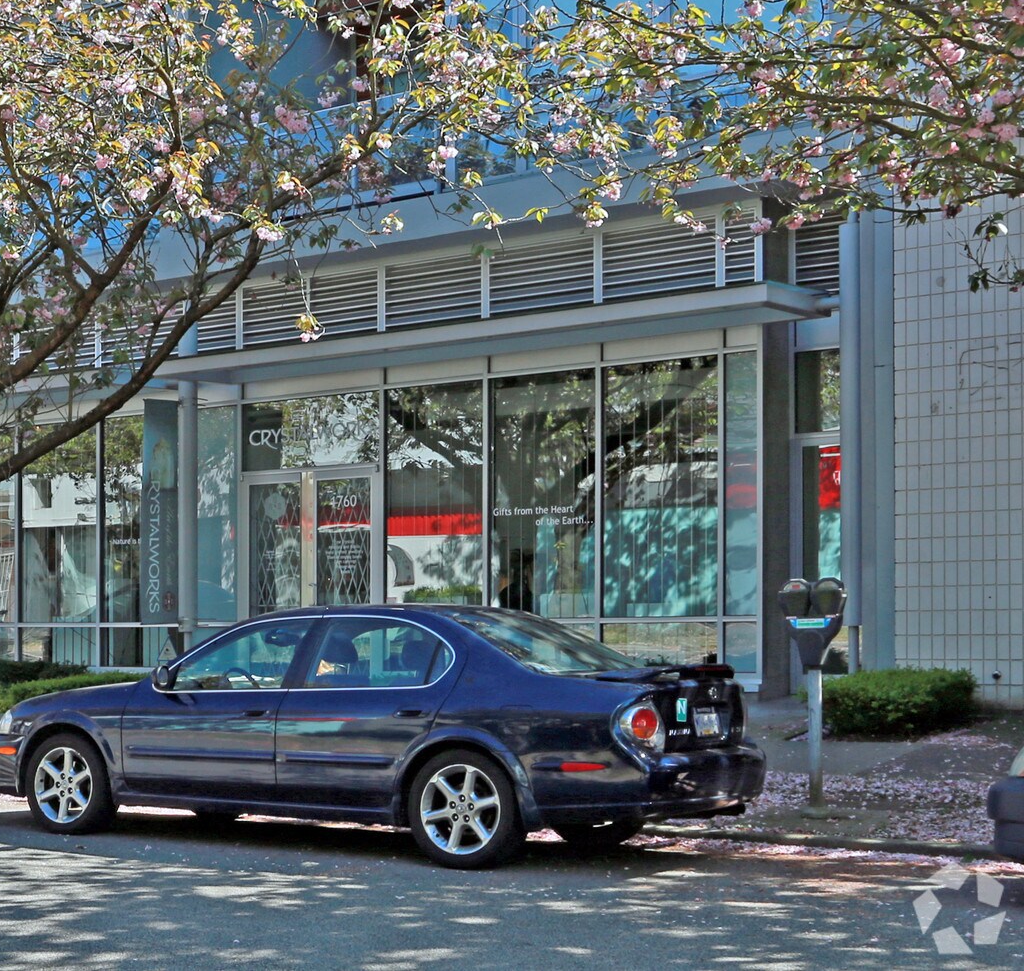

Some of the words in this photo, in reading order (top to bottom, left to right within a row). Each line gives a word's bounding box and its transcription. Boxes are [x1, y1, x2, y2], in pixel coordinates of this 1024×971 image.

[249, 419, 374, 449] CRYSTALWORK
[331, 495, 357, 508] 1760
[492, 508, 512, 516] Gifts
[514, 507, 533, 515] from
[535, 506, 548, 514] the
[550, 505, 574, 514] Heart
[535, 517, 544, 526] of
[546, 517, 560, 525] the
